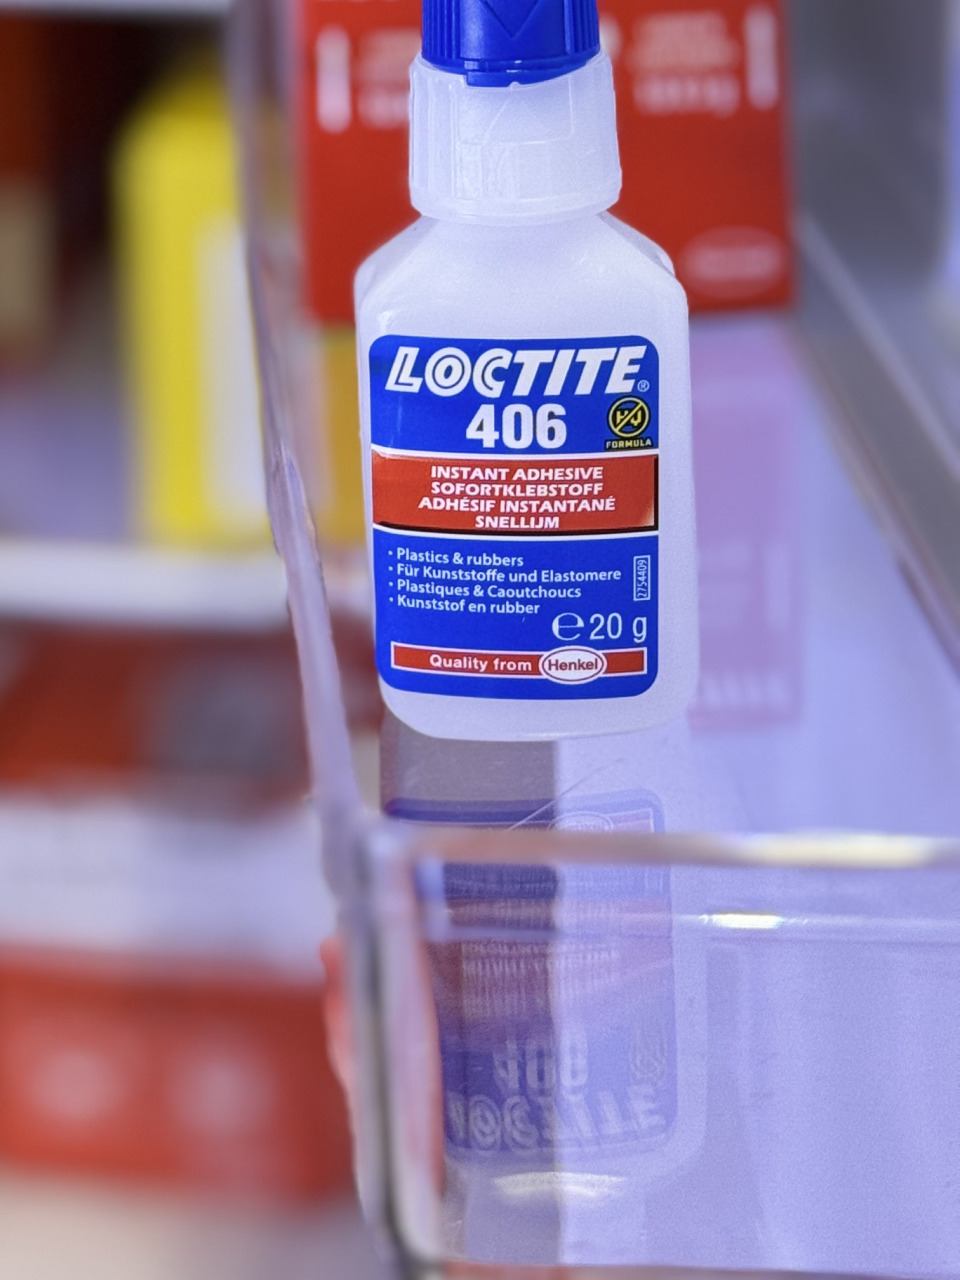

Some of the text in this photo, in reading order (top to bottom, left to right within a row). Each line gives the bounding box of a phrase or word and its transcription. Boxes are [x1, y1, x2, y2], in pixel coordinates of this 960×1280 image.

[466, 404, 567, 449] 406
[606, 439, 652, 449] FORMULA
[431, 467, 603, 480] INSTANT ADHESIVE
[431, 483, 603, 496] SOFORTKLEBSTOFF
[418, 496, 615, 512] ADHÉSIF INSTANTANÉ
[475, 516, 559, 529] SNELLIJM
[397, 548, 523, 567] Plastics & rubbers
[397, 564, 621, 582] Für Kunststoffe und Elastomere
[637, 560, 647, 598] 2754409
[397, 580, 581, 598] Plastiques & Caoutchoucs
[397, 594, 540, 614] Kunststof en rubber
[590, 616, 622, 639] 20
[633, 615, 647, 642] g
[430, 654, 532, 671] Quality from
[548, 658, 600, 672] Henkel
